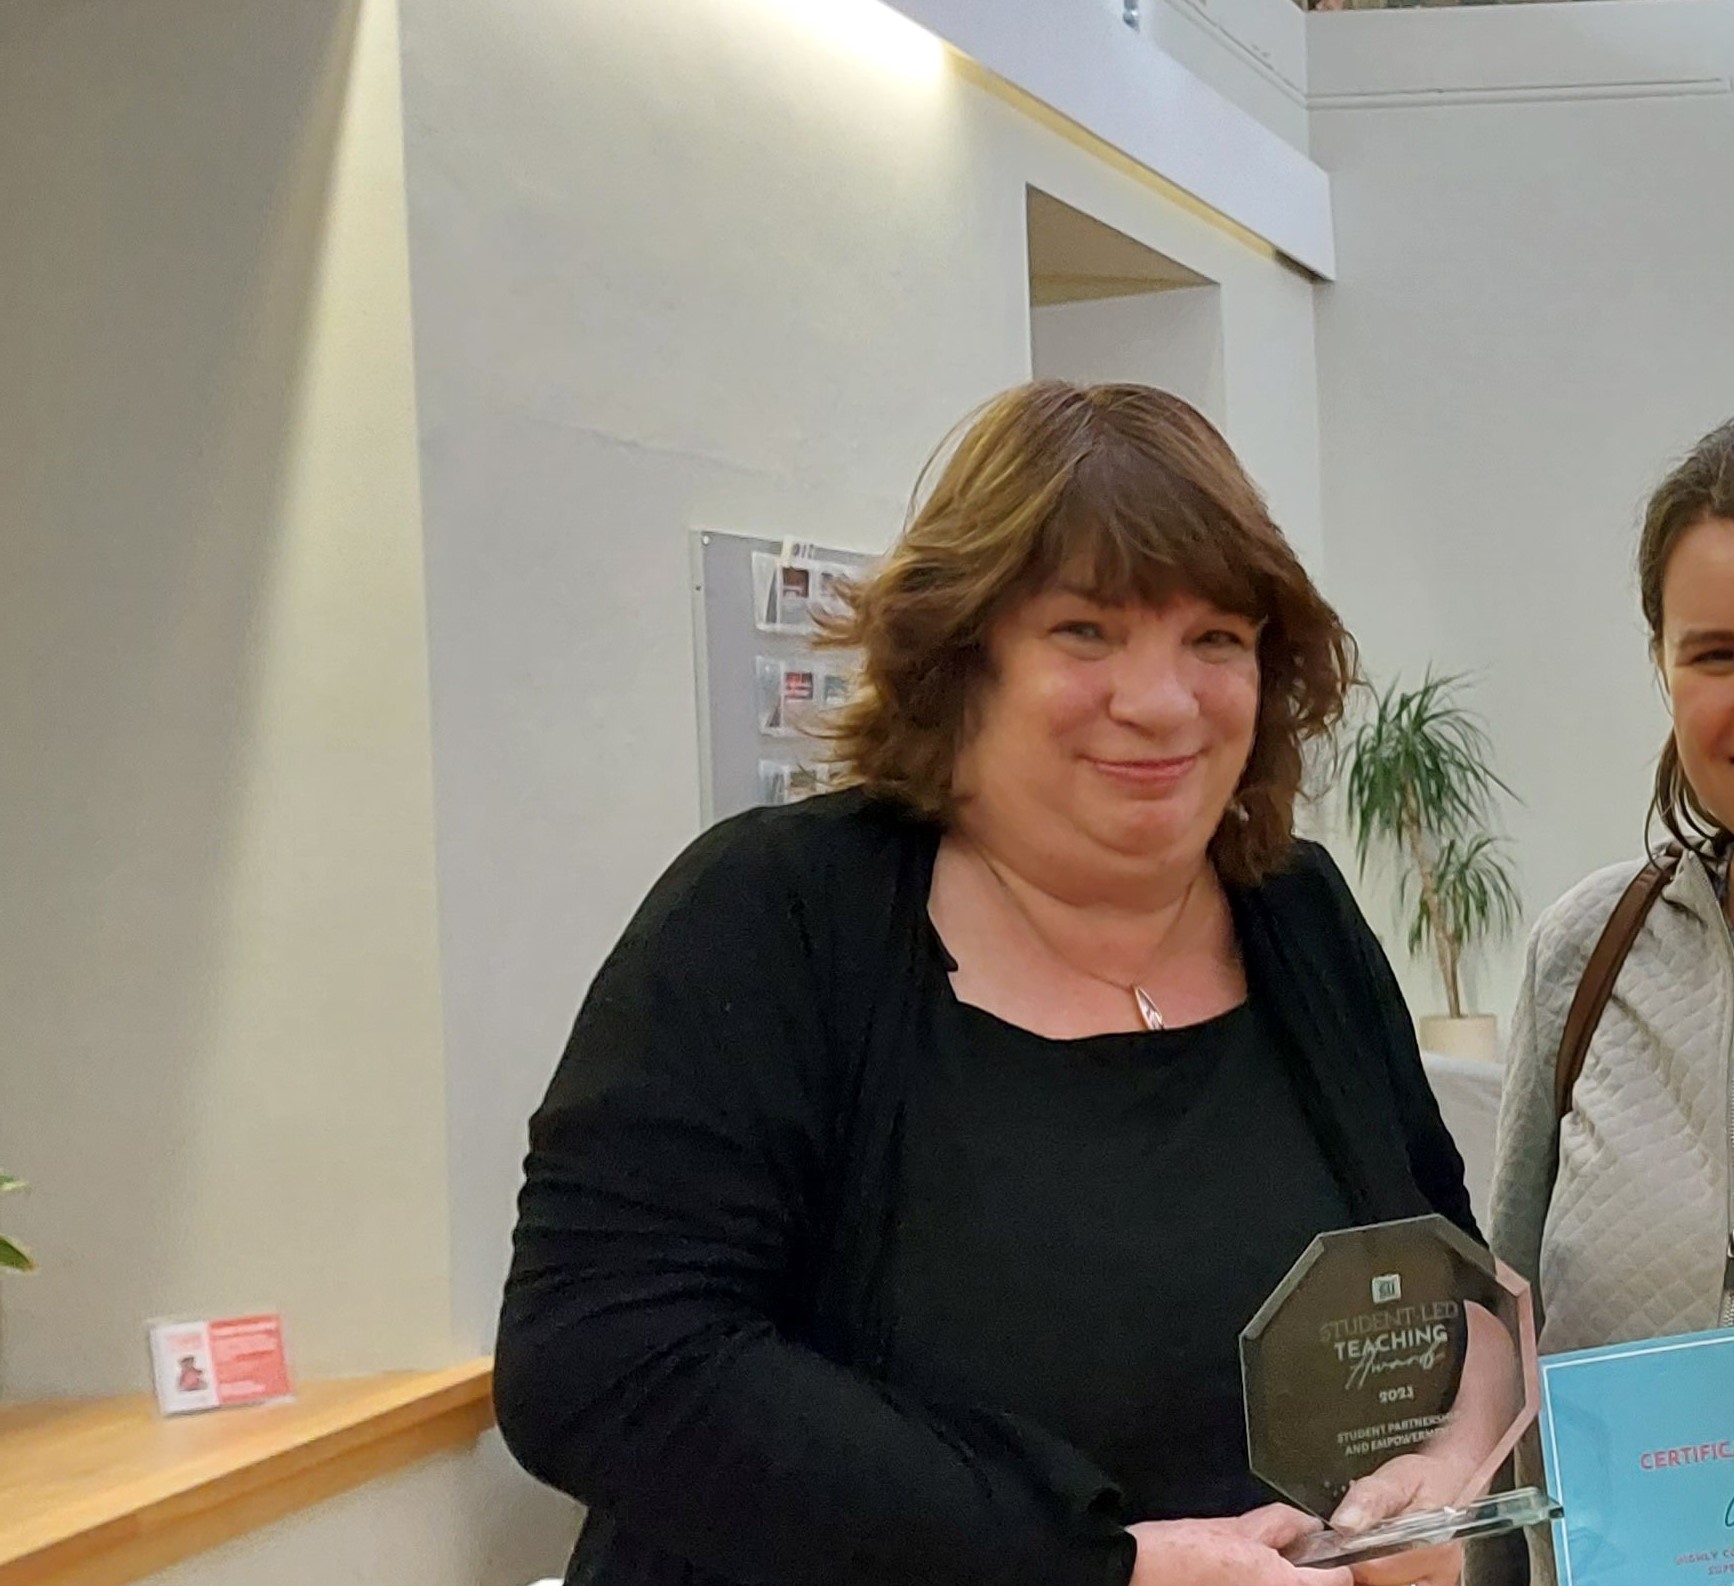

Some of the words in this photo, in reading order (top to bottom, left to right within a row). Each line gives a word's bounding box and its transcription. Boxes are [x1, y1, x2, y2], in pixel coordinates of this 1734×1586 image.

[1333, 1323, 1448, 1361] TEACHING
[1337, 1423, 1387, 1444] STUDENT
[1345, 1441, 1370, 1457] AND
[1675, 1551, 1718, 1565] HIGHLY
